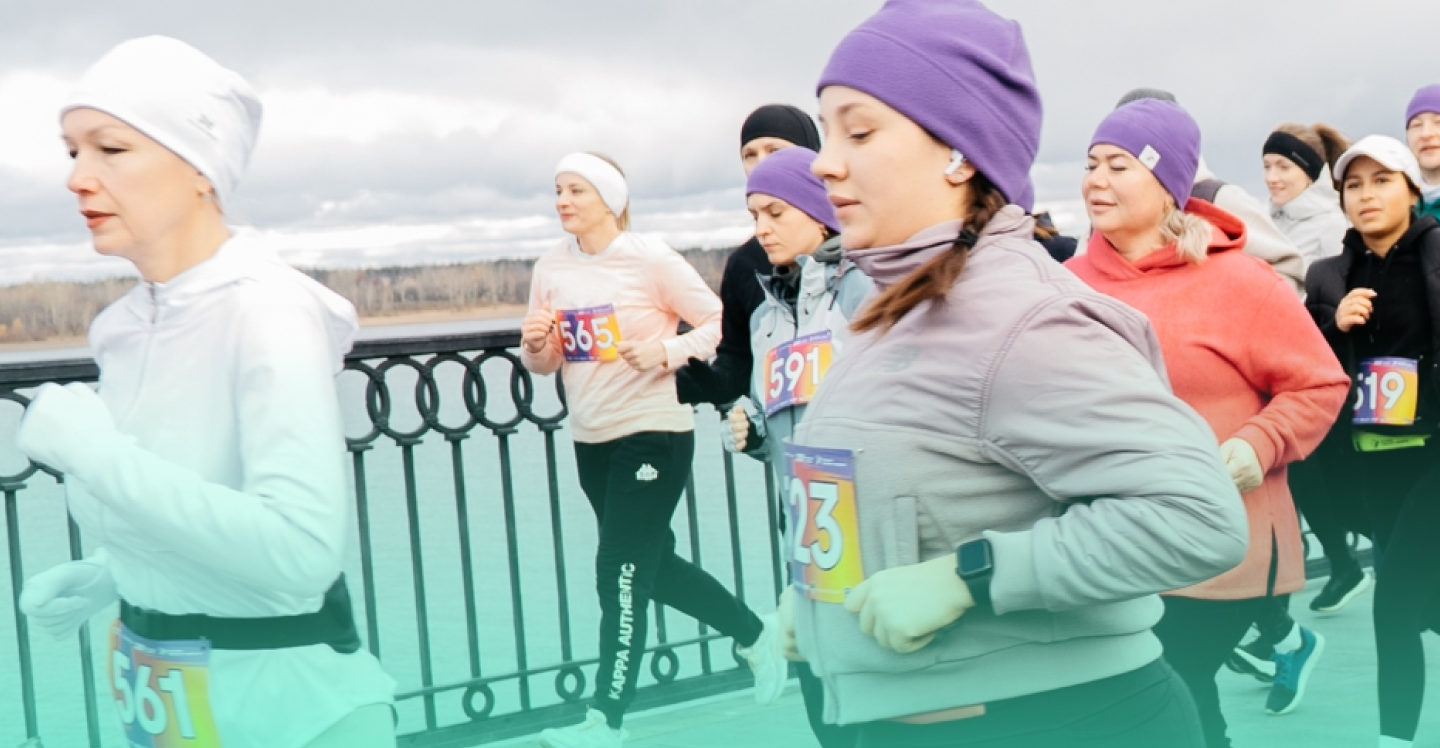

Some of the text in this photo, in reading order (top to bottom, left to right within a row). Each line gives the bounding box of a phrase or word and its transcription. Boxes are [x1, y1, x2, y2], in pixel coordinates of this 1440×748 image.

[559, 316, 613, 353] 565
[769, 346, 819, 399] 591
[784, 474, 843, 571] 23
[608, 562, 636, 700] KAPPA AUTHENTIC
[112, 649, 197, 739] 561
